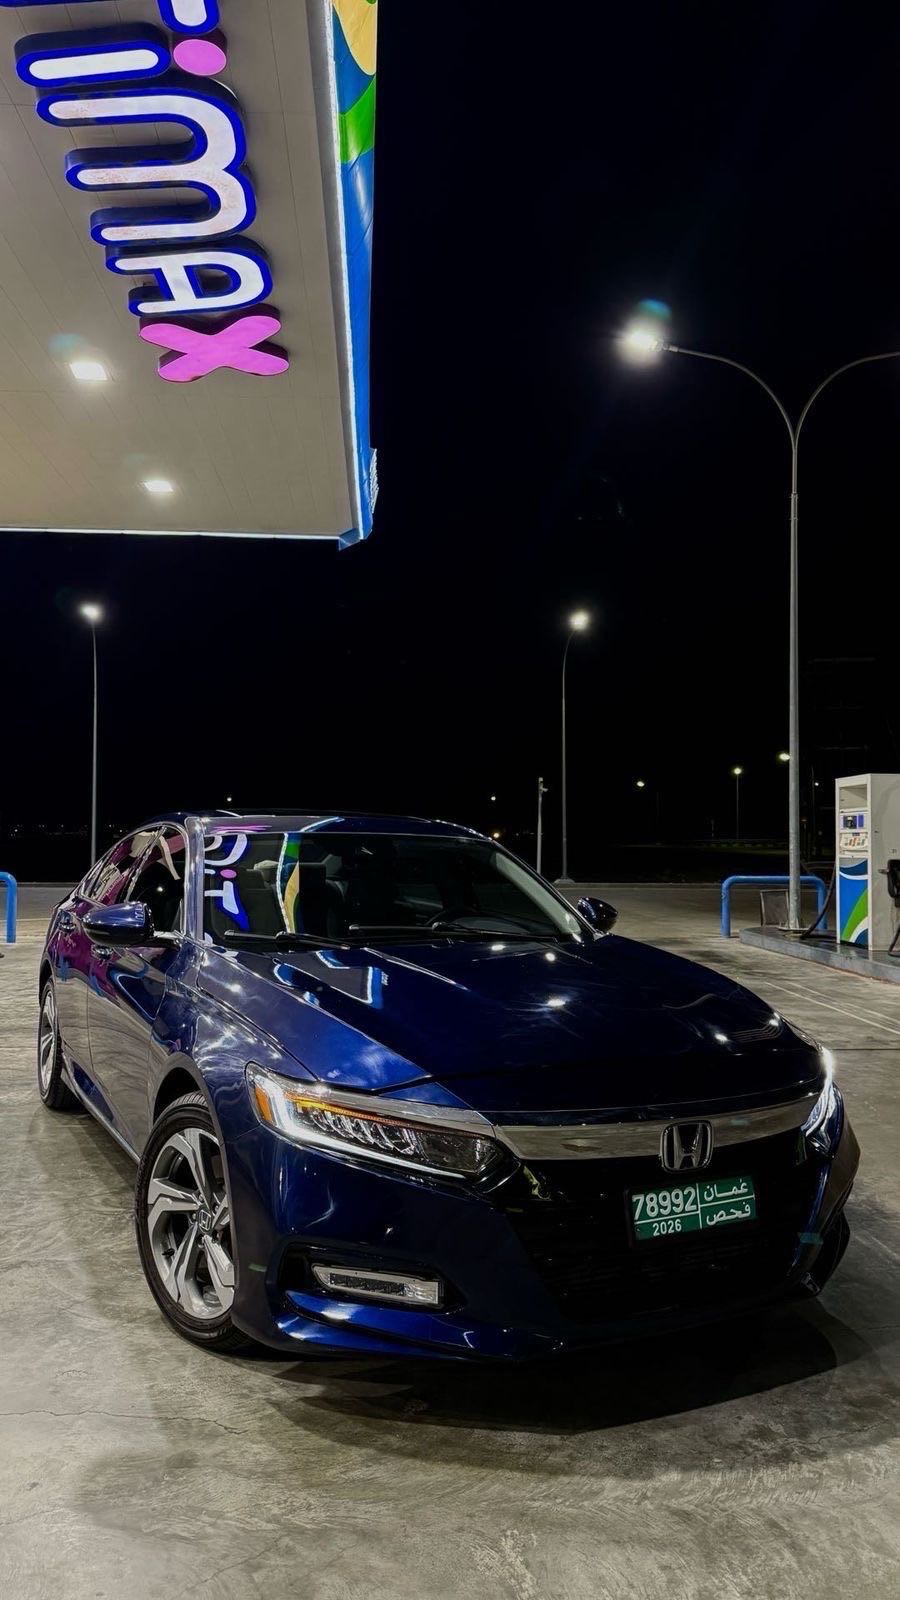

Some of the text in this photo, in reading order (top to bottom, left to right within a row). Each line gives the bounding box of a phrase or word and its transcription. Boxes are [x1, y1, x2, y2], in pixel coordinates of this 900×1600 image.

[632, 1187, 697, 1221] 78992
[706, 1202, 751, 1226] فحص
[652, 1219, 682, 1237] 2026
